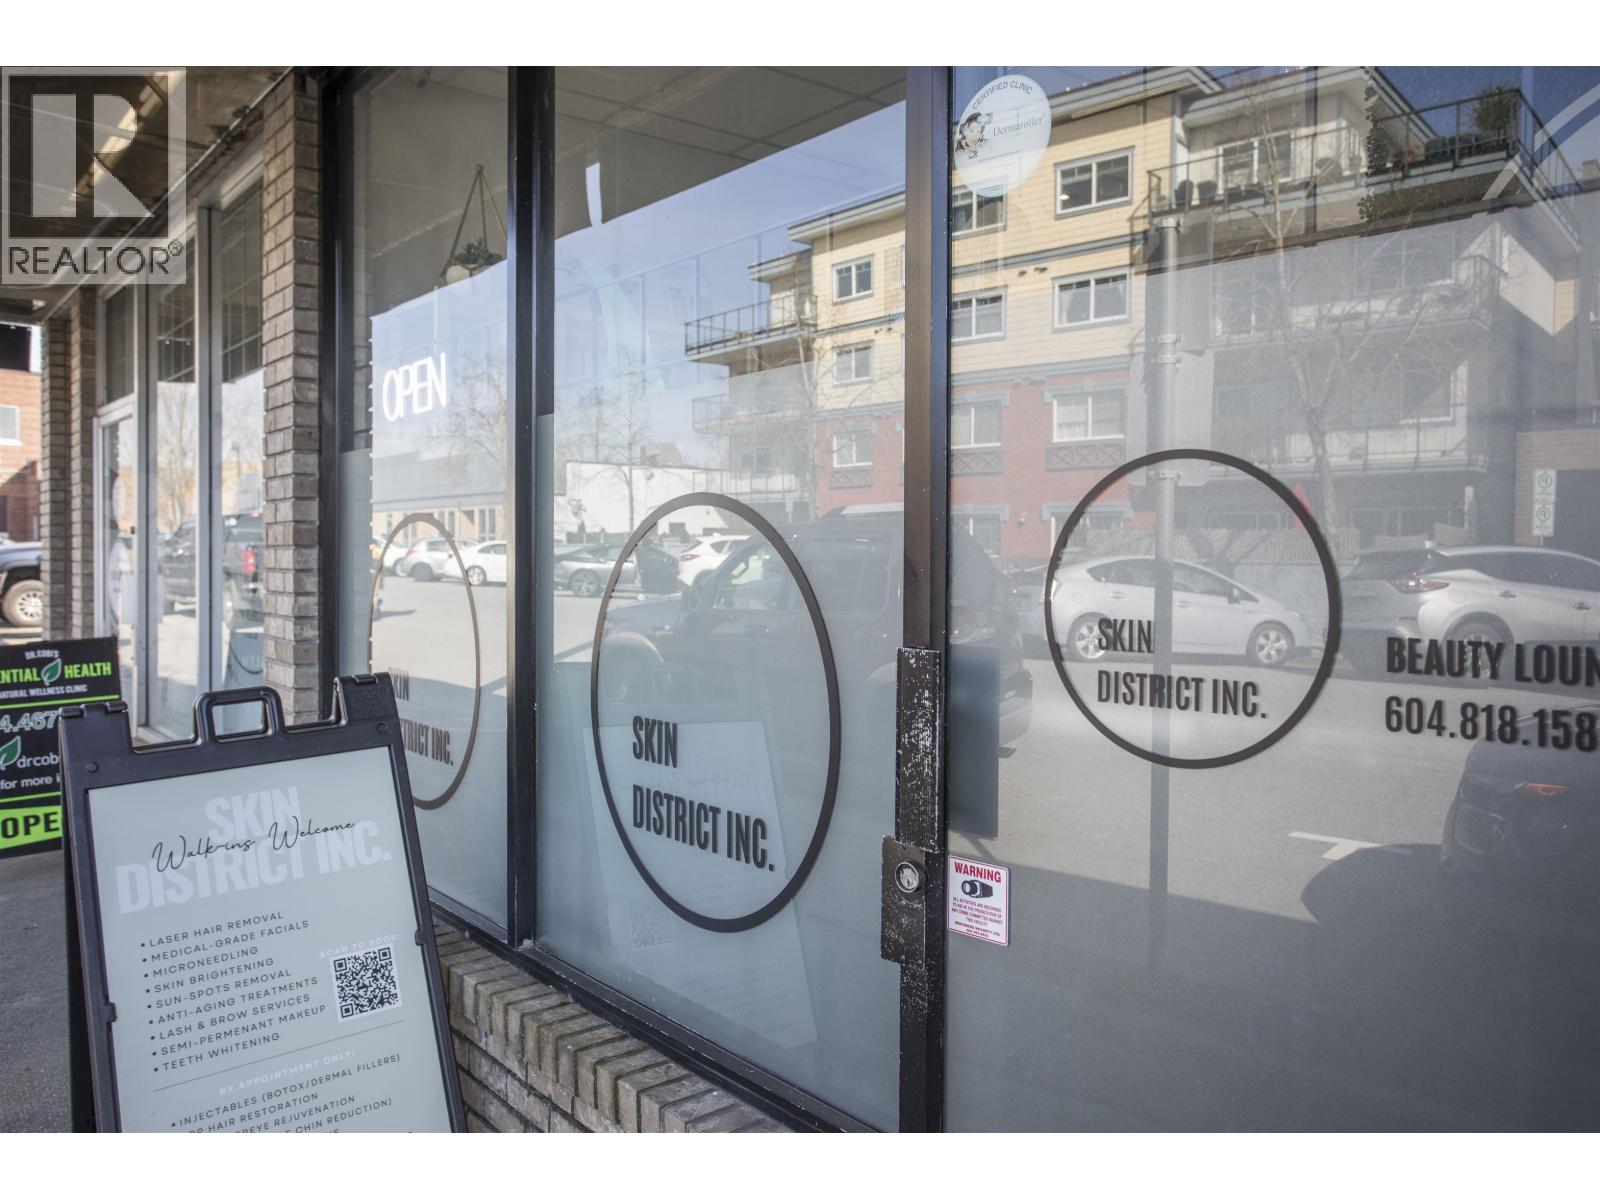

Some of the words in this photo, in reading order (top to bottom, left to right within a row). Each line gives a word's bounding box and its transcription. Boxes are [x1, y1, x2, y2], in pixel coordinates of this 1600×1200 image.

[972, 81, 1009, 110] CERTIFIED
[1009, 80, 1033, 95] CLINIC
[382, 352, 447, 421] OPEN
[1098, 617, 1152, 654] SKIN
[64, 662, 112, 679] HEALTH
[1386, 636, 1504, 680] BEAUTY
[29, 686, 65, 697] WELLNESS
[65, 684, 88, 693] CLINIC
[1098, 670, 1204, 713] DISTRICT
[1212, 678, 1268, 719] INC.
[400, 717, 430, 758] TRICT
[431, 727, 454, 766] INC.
[632, 715, 678, 768] SKIN
[1385, 695, 1598, 753] 604.818.158
[0, 779, 18, 790] for
[21, 776, 53, 788] more
[1, 811, 60, 839] OPE
[205, 785, 301, 845] SKIN
[268, 815, 356, 851] Welcome
[632, 784, 721, 854] DISTRICT
[727, 810, 775, 872] INC.
[115, 834, 306, 914] DISTRICT
[315, 820, 392, 875] INC.
[954, 861, 1002, 883] WARNING
[149, 930, 189, 948] LASER
[193, 924, 223, 939] HAIR
[227, 911, 284, 931] REMOVAL
[151, 932, 256, 963] MEDICAL-GRADE
[260, 920, 309, 938] FACIALS
[153, 946, 259, 978] MICRONEEDLING
[154, 978, 185, 993] SKIN
[189, 957, 275, 985] BRIGHTENING
[156, 983, 230, 1009] SUN-SPOTS
[235, 969, 292, 990] REMOVAL
[157, 997, 236, 1025] ANTI-AGING
[241, 977, 319, 1003] TREATMENTS
[159, 1025, 193, 1040] LASH
[197, 1020, 206, 1031] &
[210, 1011, 248, 1027] BROW
[252, 993, 311, 1016] SERVICES
[160, 1018, 273, 1056] SEMI-PERMENANT
[279, 1004, 327, 1023] MAKEUP
[162, 1053, 204, 1072] TEETH
[208, 1032, 281, 1060] WHITENING
[179, 1096, 258, 1127] INJECTABLES
[262, 1068, 353, 1103] (BOTOX/DERMAL
[356, 1053, 401, 1074] FILLERS)
[218, 1084, 235, 1096] BY
[238, 1060, 320, 1090] APPOINTMENT
[208, 1118, 236, 1132] HAIR
[240, 1092, 318, 1123] RESTORATION
[274, 1095, 355, 1127] REJUVENATION
[295, 1120, 323, 1133] CHIN
[327, 1097, 392, 1125] REDUCTION)
